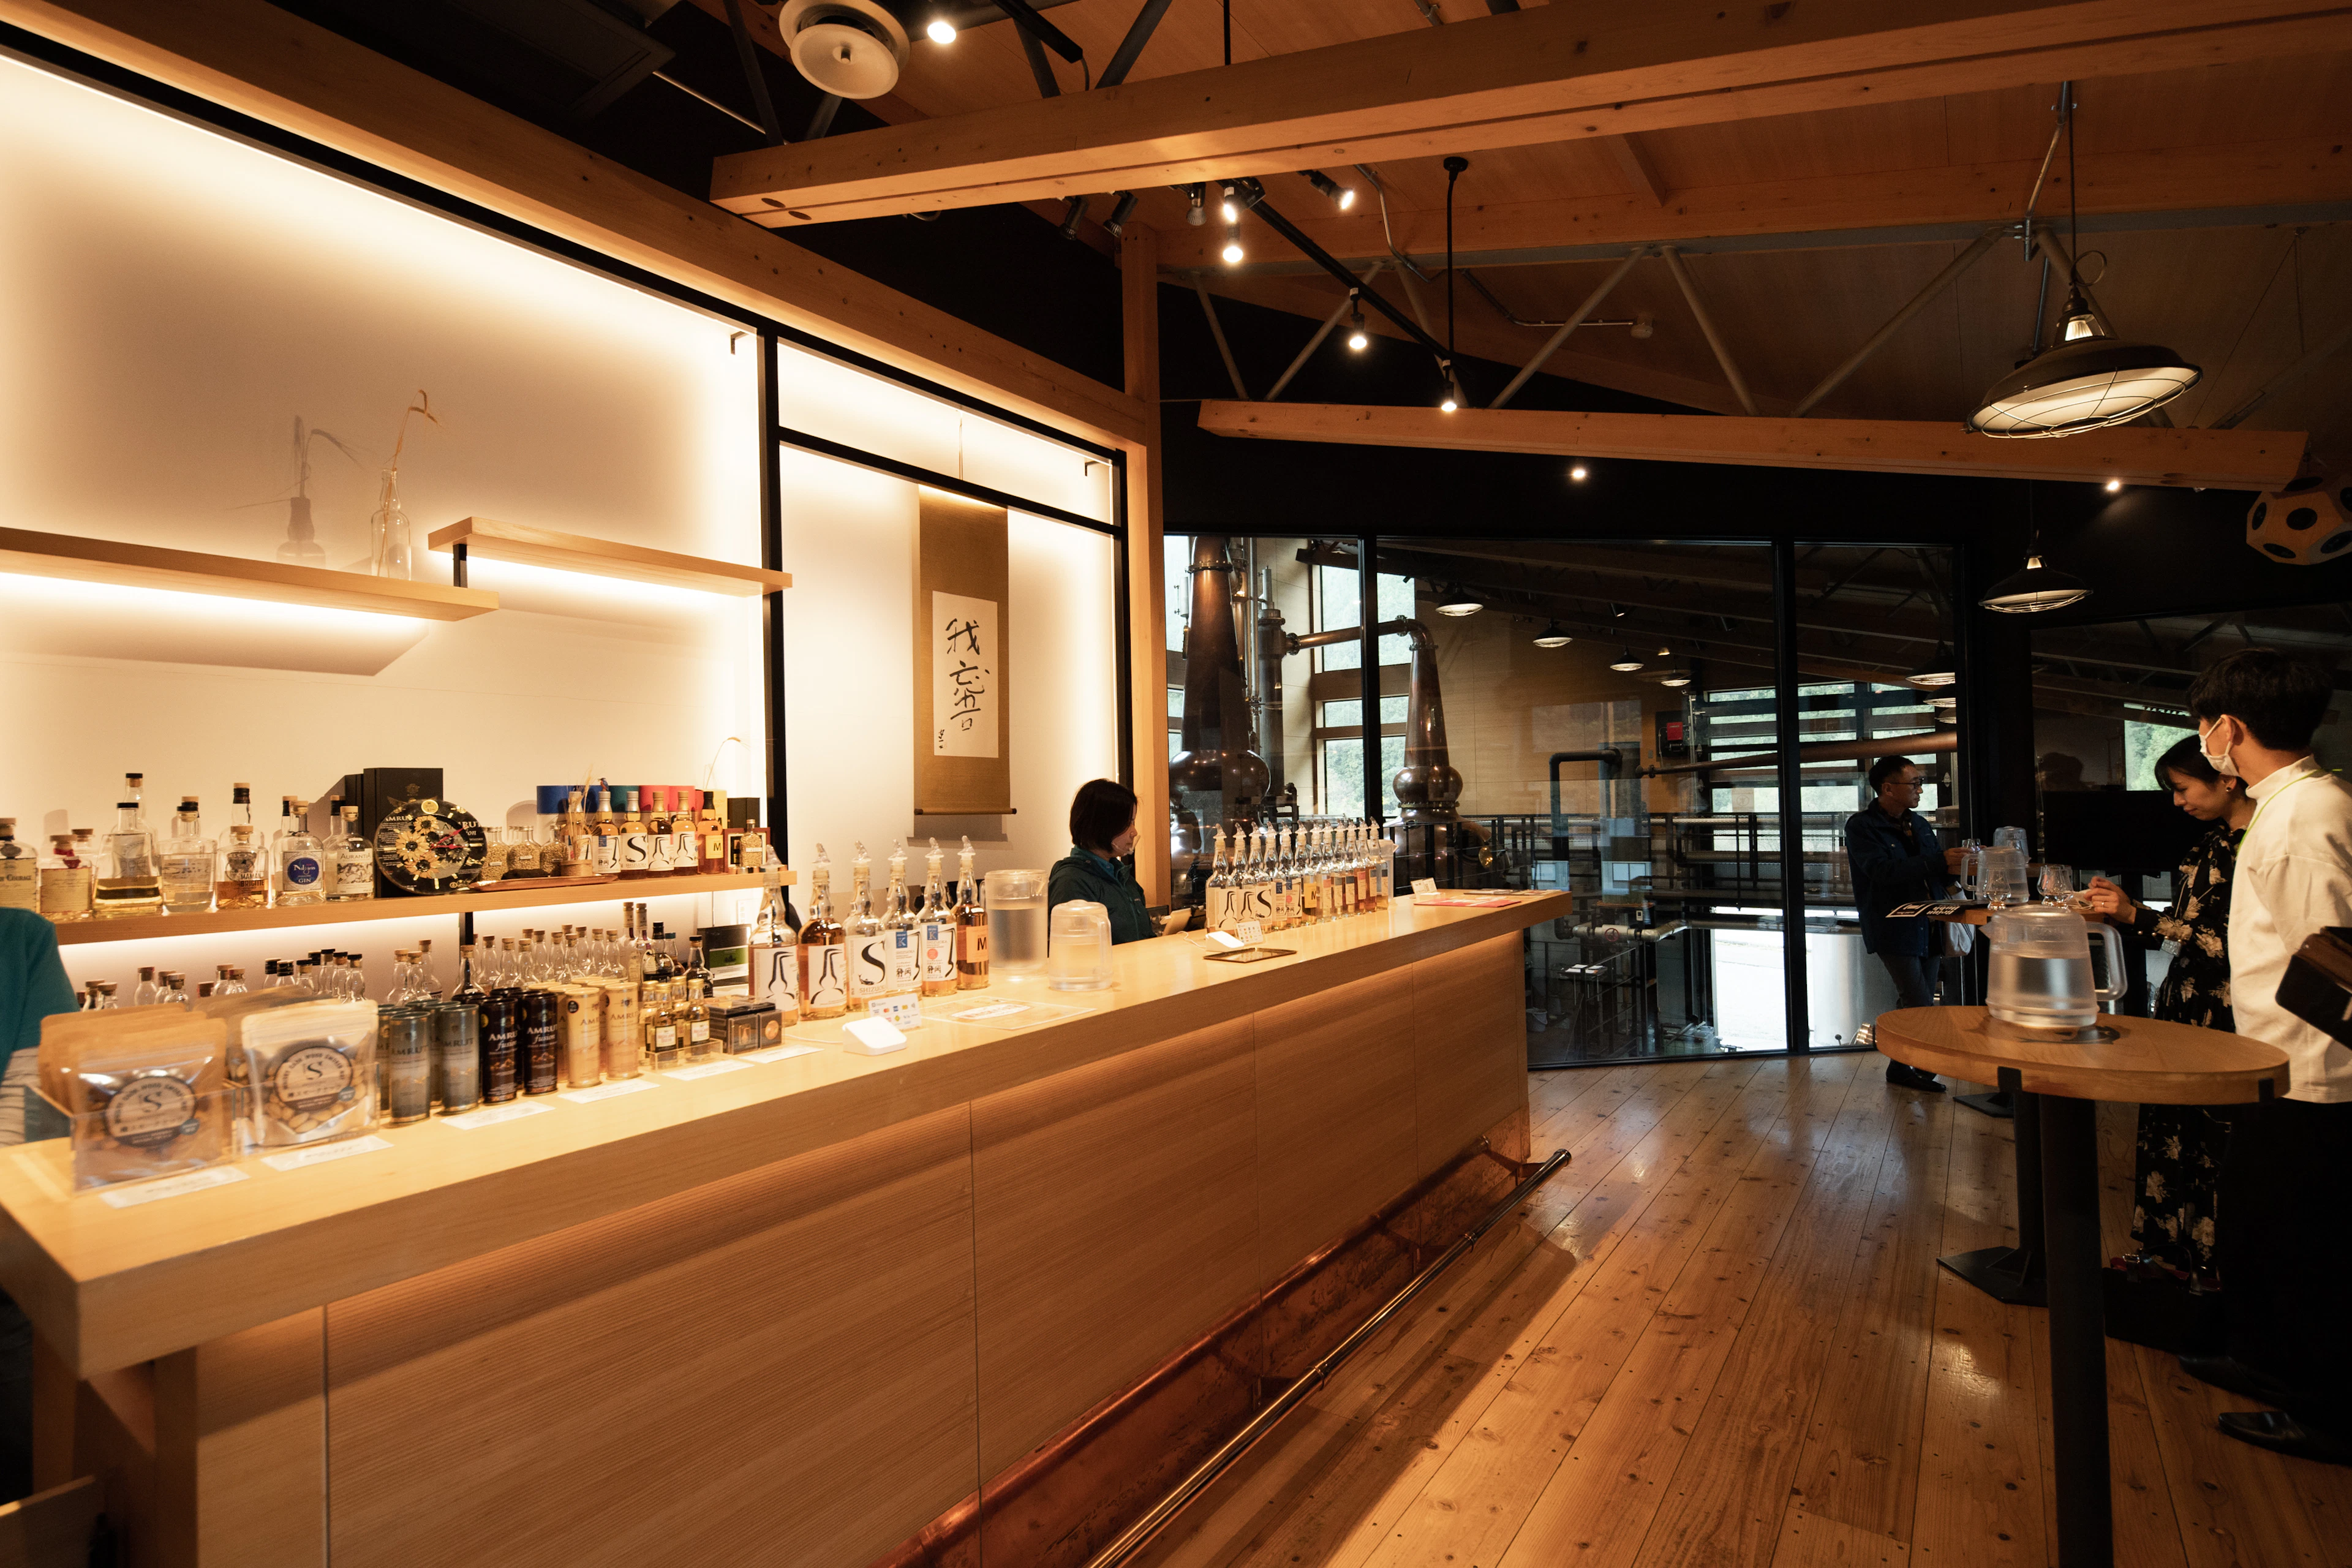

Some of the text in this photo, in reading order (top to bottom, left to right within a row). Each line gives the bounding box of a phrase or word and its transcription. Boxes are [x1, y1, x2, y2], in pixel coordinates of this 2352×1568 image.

[713, 842, 722, 851] M
[929, 931, 937, 940] K
[897, 937, 907, 946] K
[488, 1030, 518, 1041] AMRU
